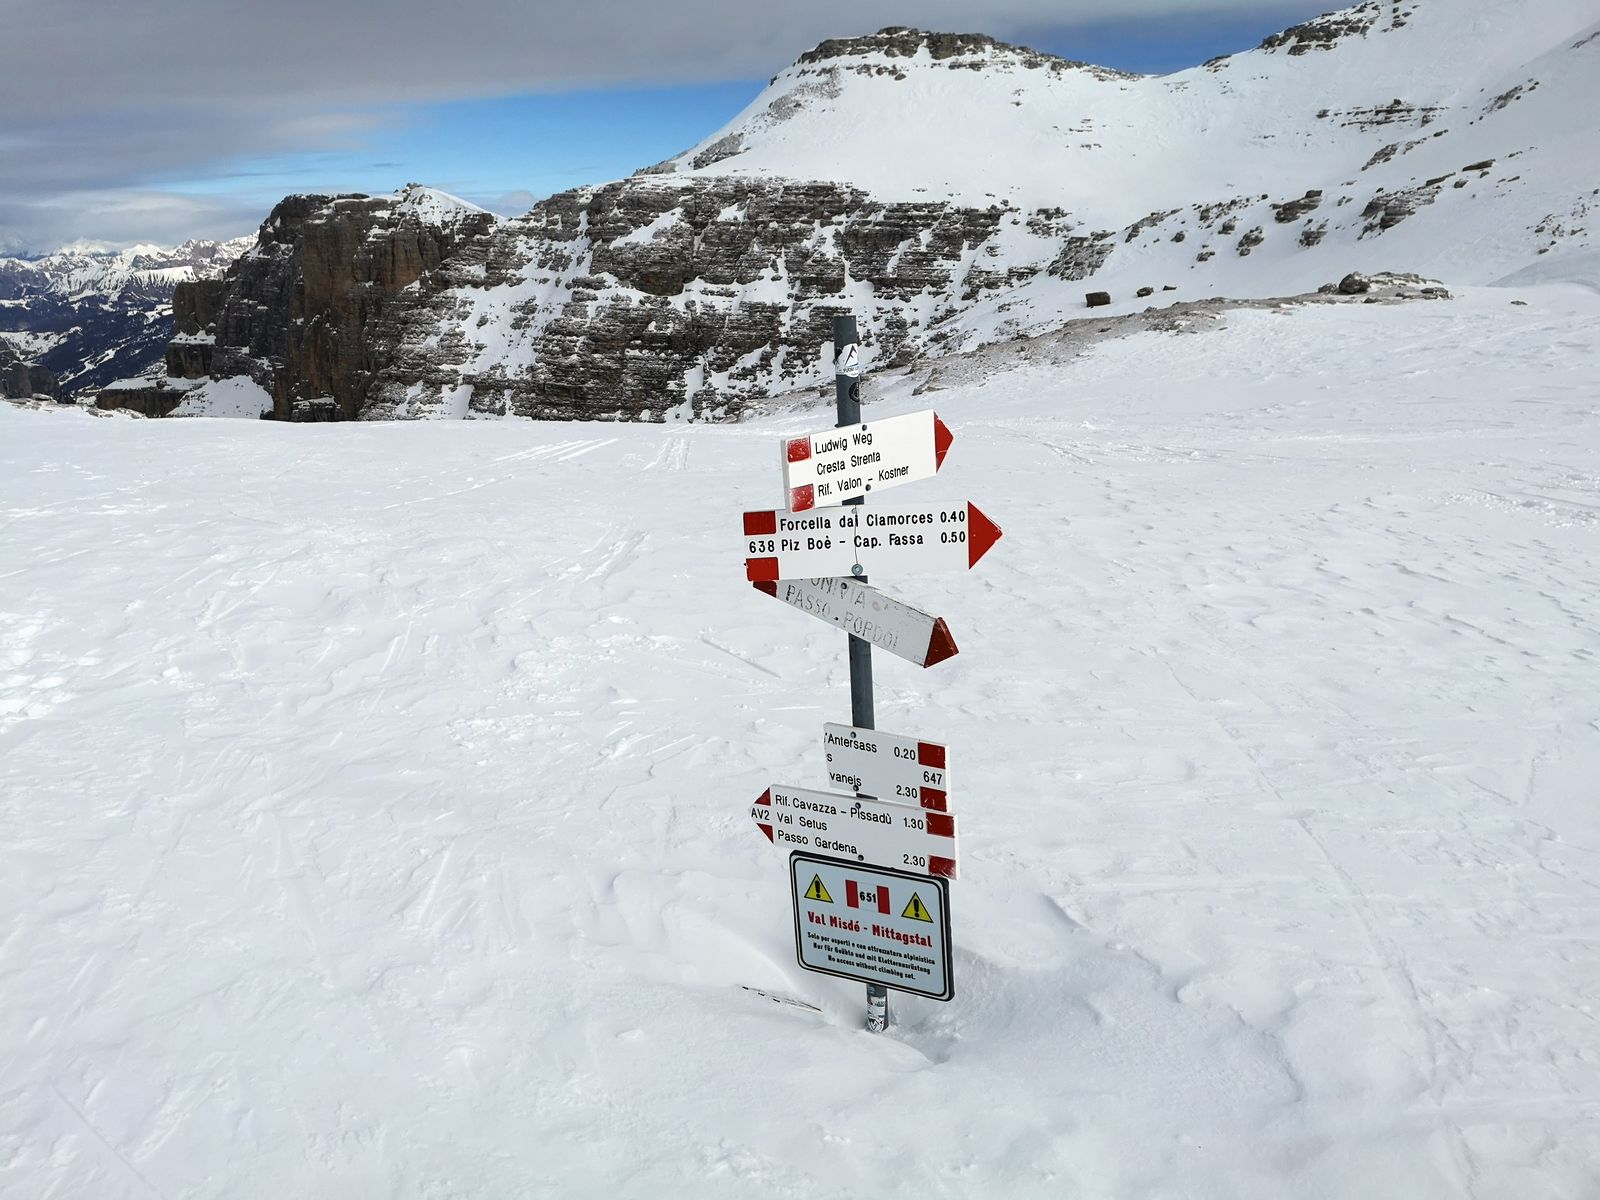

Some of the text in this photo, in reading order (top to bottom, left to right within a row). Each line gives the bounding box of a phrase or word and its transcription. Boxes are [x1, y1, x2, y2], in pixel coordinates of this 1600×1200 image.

[815, 432, 873, 455] Ludwig Weg
[816, 451, 881, 475] Cresta Strenta
[818, 484, 833, 497] Rif.
[837, 476, 862, 492] Valon
[878, 465, 909, 482] Kostner
[780, 510, 966, 531] Forcella dai Ciamorces 0.40
[749, 540, 776, 553] 638
[781, 538, 800, 551] Piz
[807, 535, 832, 550] Boè
[854, 535, 882, 548] Cap.
[889, 533, 924, 546] Fassa
[940, 531, 966, 544] 0.50
[785, 584, 831, 619] PASSO
[803, 577, 866, 608] UNIVIA
[894, 746, 916, 760] 0.20
[923, 770, 942, 785] 647
[896, 785, 918, 799] 2.30
[751, 808, 770, 821] AV2
[775, 794, 791, 807] Rif.
[792, 797, 837, 815] Cavazza
[850, 807, 892, 825] Pissadù
[903, 817, 924, 830] 1.30
[777, 812, 828, 831] Val Setus
[778, 829, 926, 867] Passo Gardena 2.30
[859, 890, 877, 903] 651
[807, 910, 826, 926] Val
[829, 915, 860, 933] Misdé
[872, 924, 933, 948] Mittagstal
[807, 931, 820, 940] Solo
[821, 935, 830, 943] per
[831, 938, 851, 947] esperti
[867, 945, 903, 958] attrezzatura
[903, 953, 936, 965] alpinistica
[813, 942, 823, 950] Nur
[824, 944, 833, 952] für
[834, 946, 854, 957] Geübte
[877, 956, 931, 975] Kletterausrüstung
[827, 954, 836, 962] No
[836, 958, 855, 967] access
[855, 962, 878, 972] without
[878, 965, 904, 979] climbing
